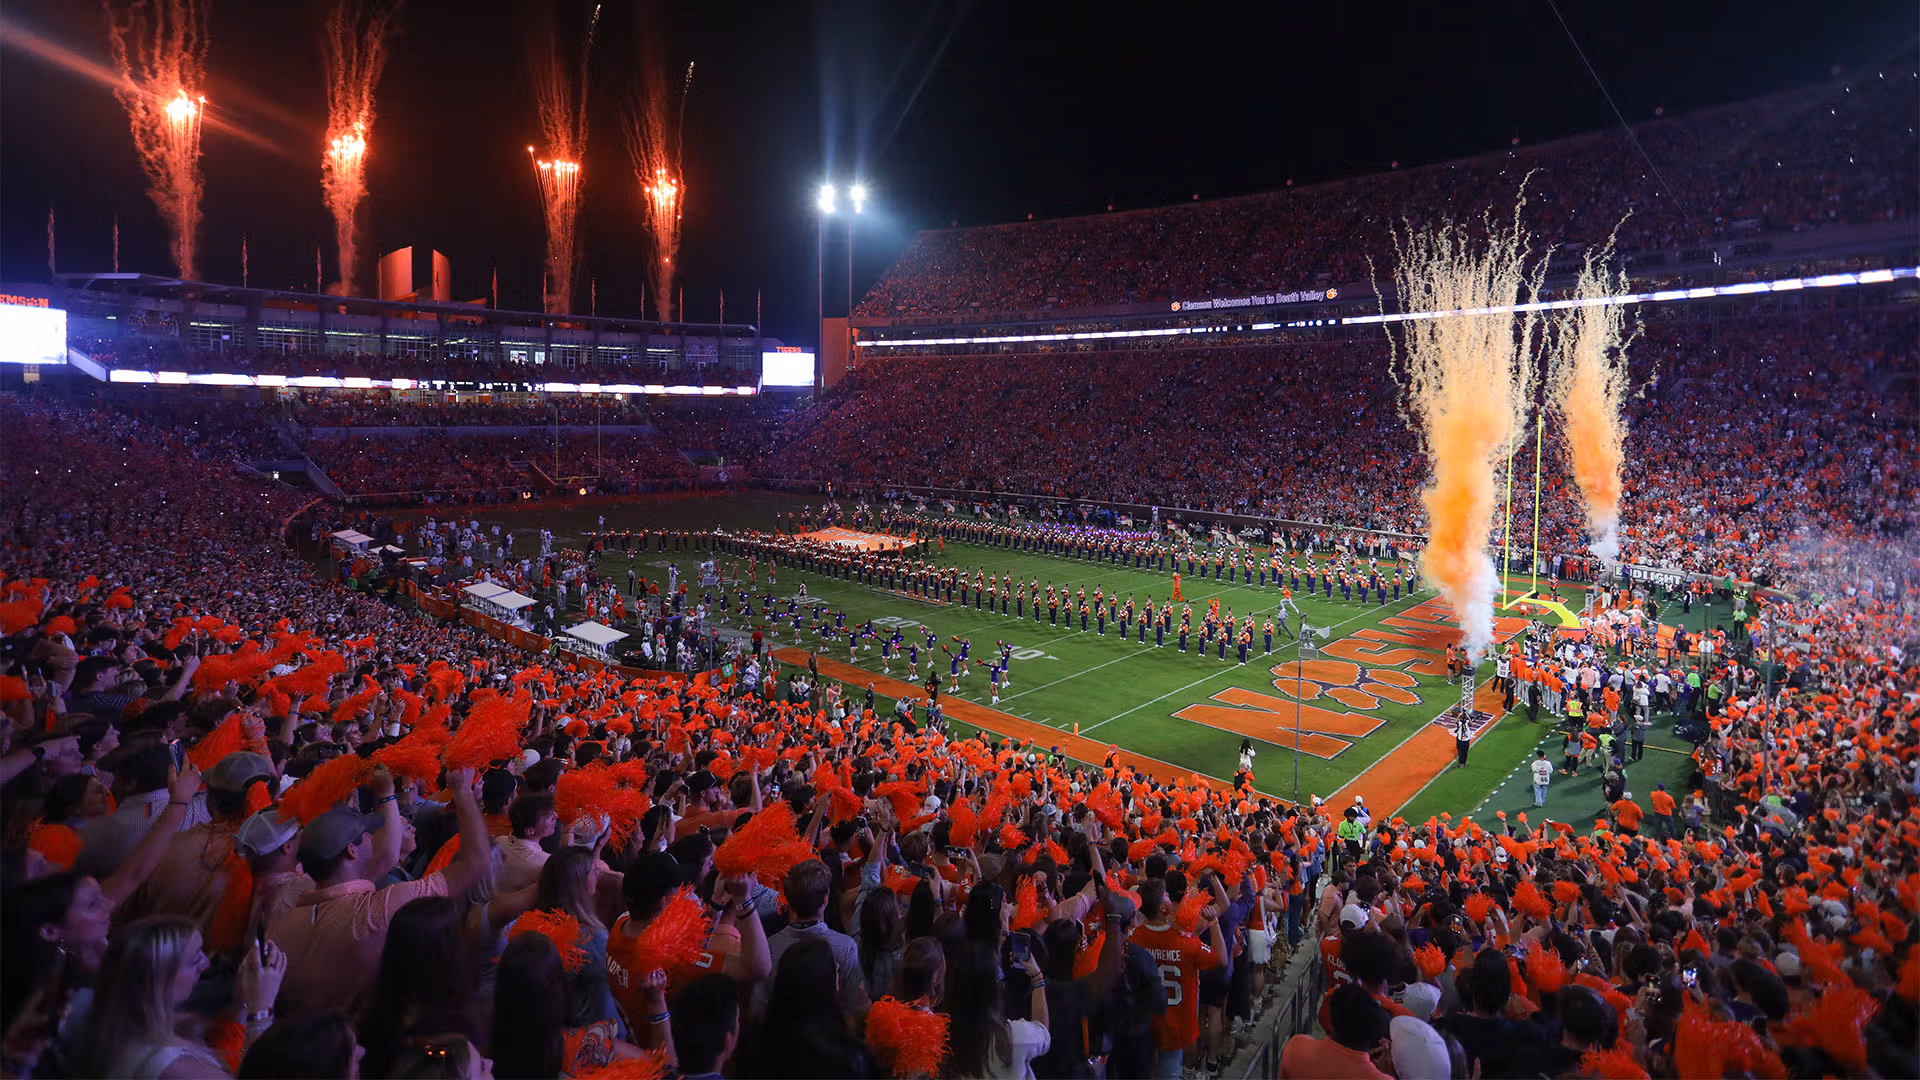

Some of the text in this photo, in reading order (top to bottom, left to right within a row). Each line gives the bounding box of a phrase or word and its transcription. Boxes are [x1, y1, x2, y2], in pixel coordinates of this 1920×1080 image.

[1213, 298, 1251, 308] Welcomes
[1251, 295, 1265, 305] You
[1266, 294, 1275, 304] to
[1276, 292, 1299, 304] Death
[1300, 290, 1325, 302] Valley
[1145, 948, 1181, 961] WRENCE
